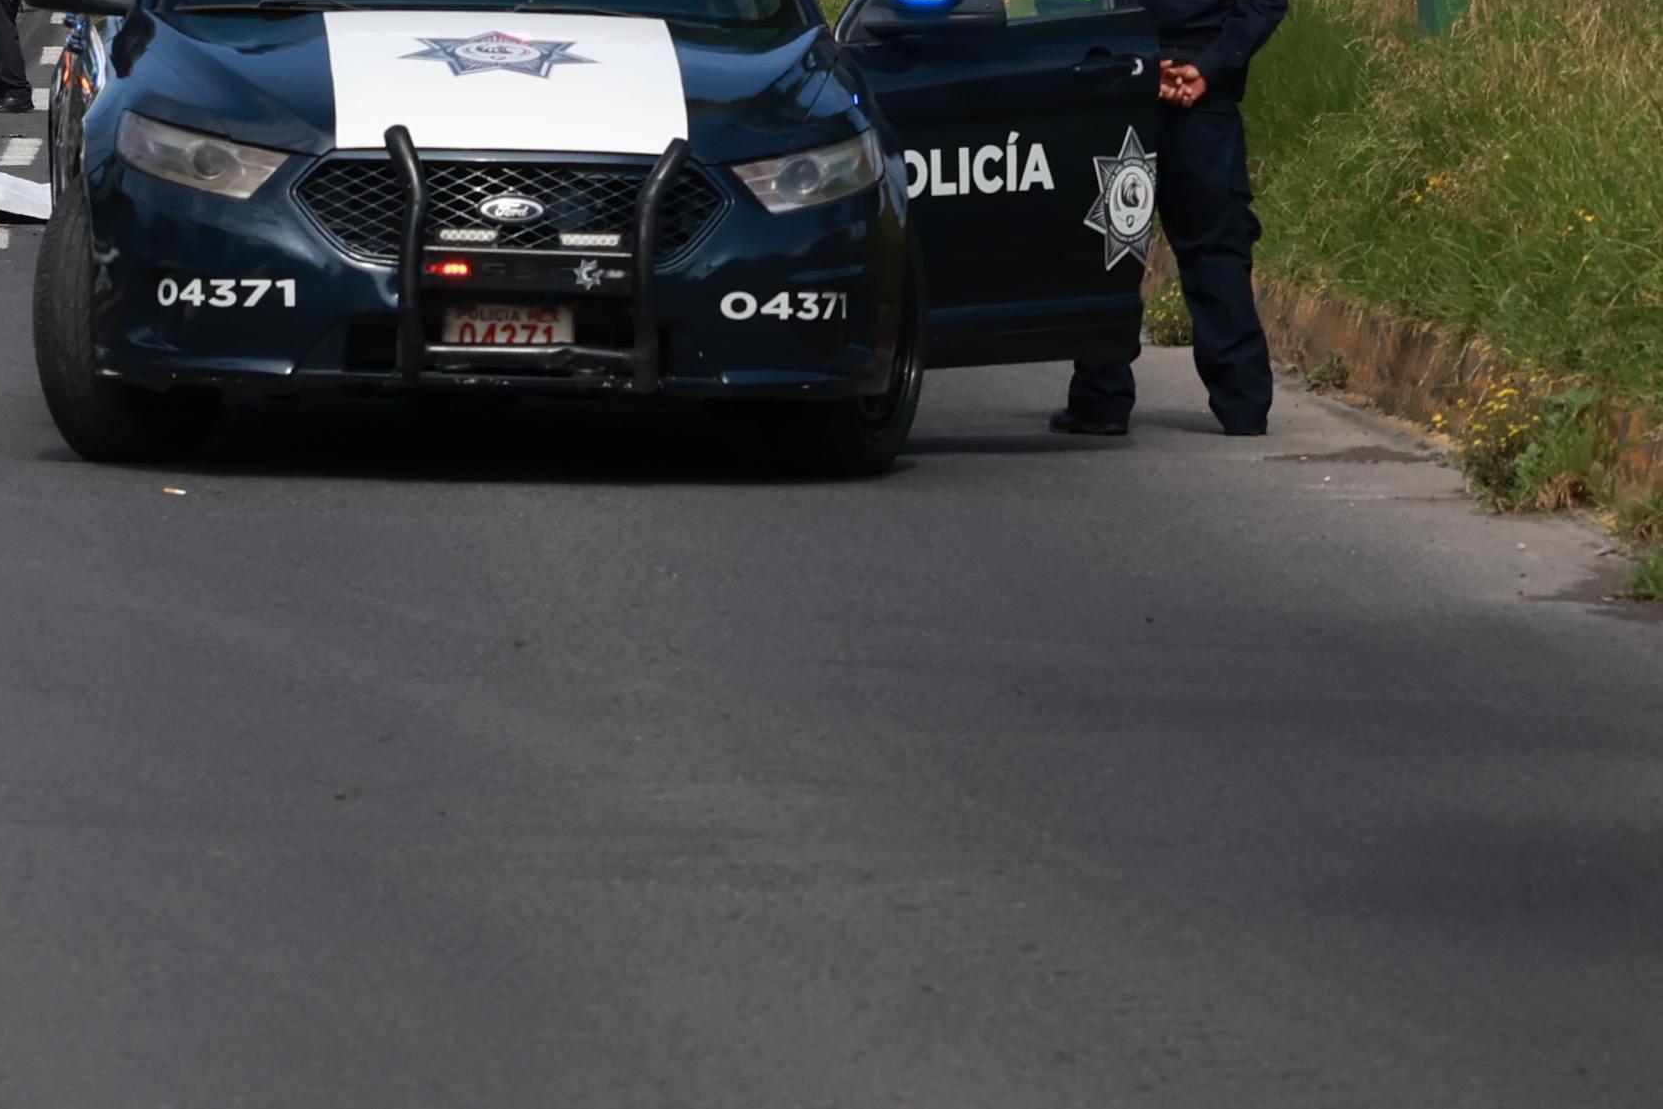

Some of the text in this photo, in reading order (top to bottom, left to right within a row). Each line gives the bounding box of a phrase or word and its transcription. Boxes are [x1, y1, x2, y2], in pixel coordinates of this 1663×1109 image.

[903, 130, 1056, 200] OLICÍA
[157, 278, 296, 308] 04371
[720, 291, 848, 321] 04371
